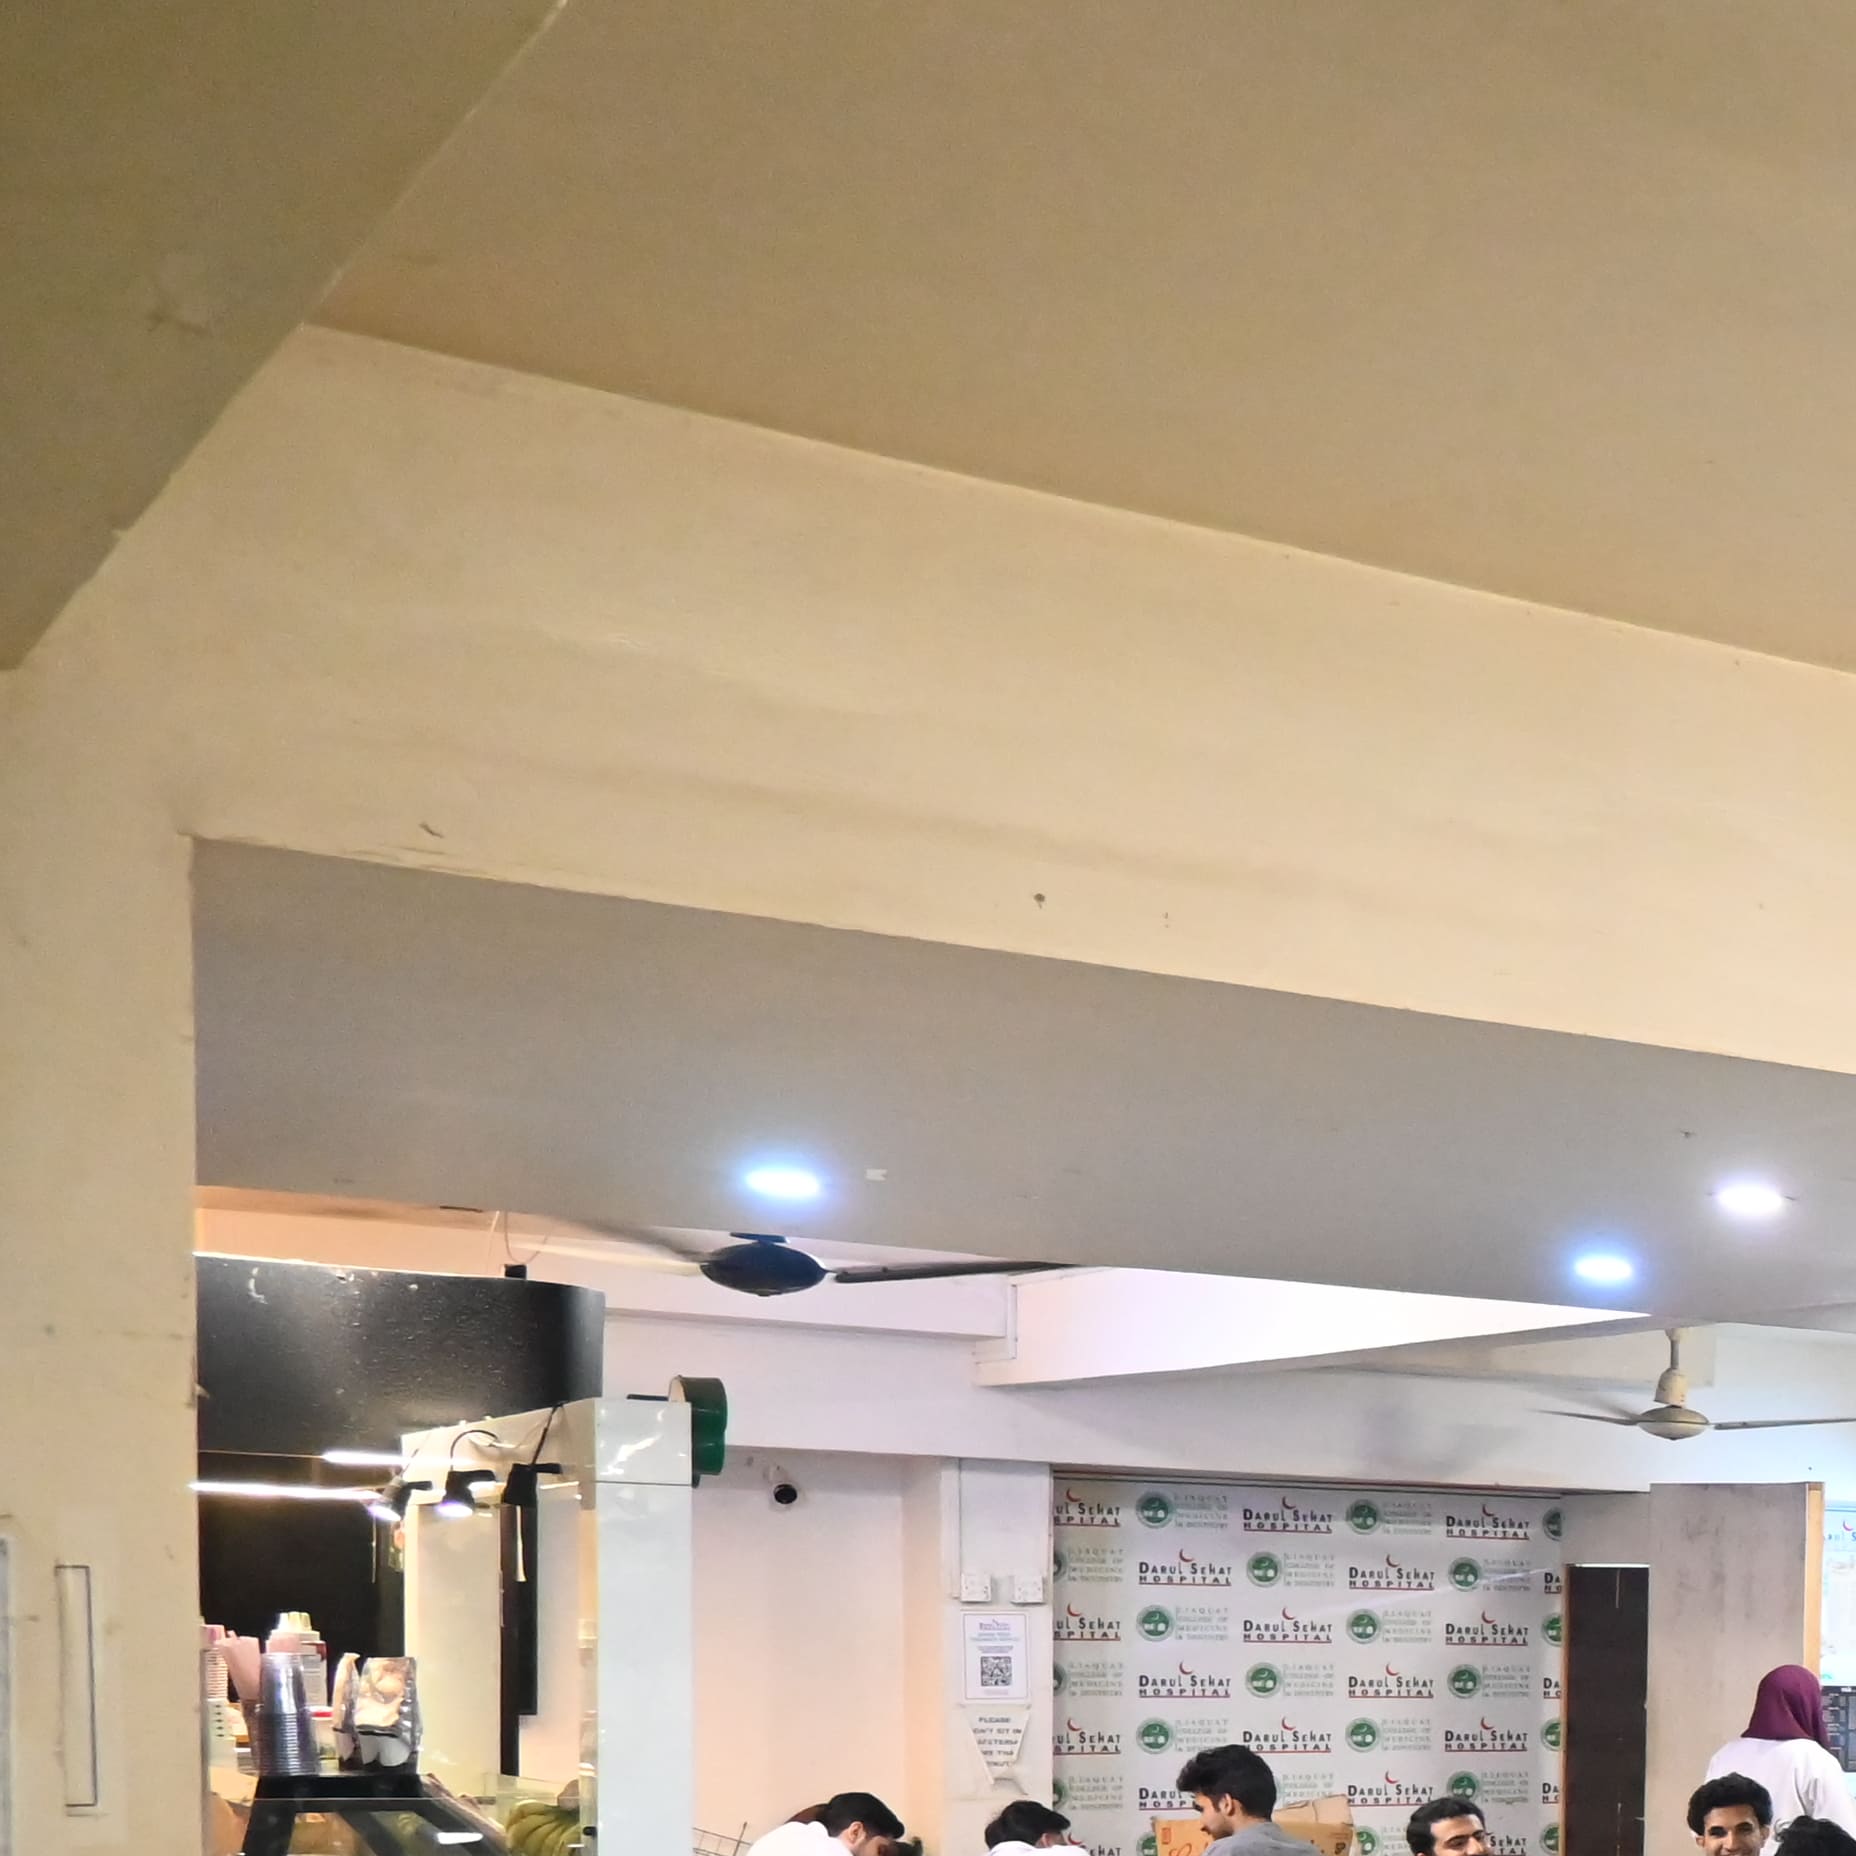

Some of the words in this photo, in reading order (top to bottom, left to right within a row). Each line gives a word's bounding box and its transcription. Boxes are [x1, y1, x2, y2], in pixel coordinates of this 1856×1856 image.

[1054, 1517, 1121, 1525] SPITAL
[1244, 1523, 1332, 1531] HOSPITAL
[1447, 1529, 1529, 1537] HOSPITAL
[1139, 1576, 1232, 1584] HOSPITAL
[1350, 1581, 1435, 1589] HOSPITAL
[1054, 1631, 1121, 1639] SPITAL
[1446, 1636, 1529, 1644] HOSPITAL
[1445, 1743, 1528, 1751] HOSPITAL
[1139, 1801, 1194, 1809] HOSP
